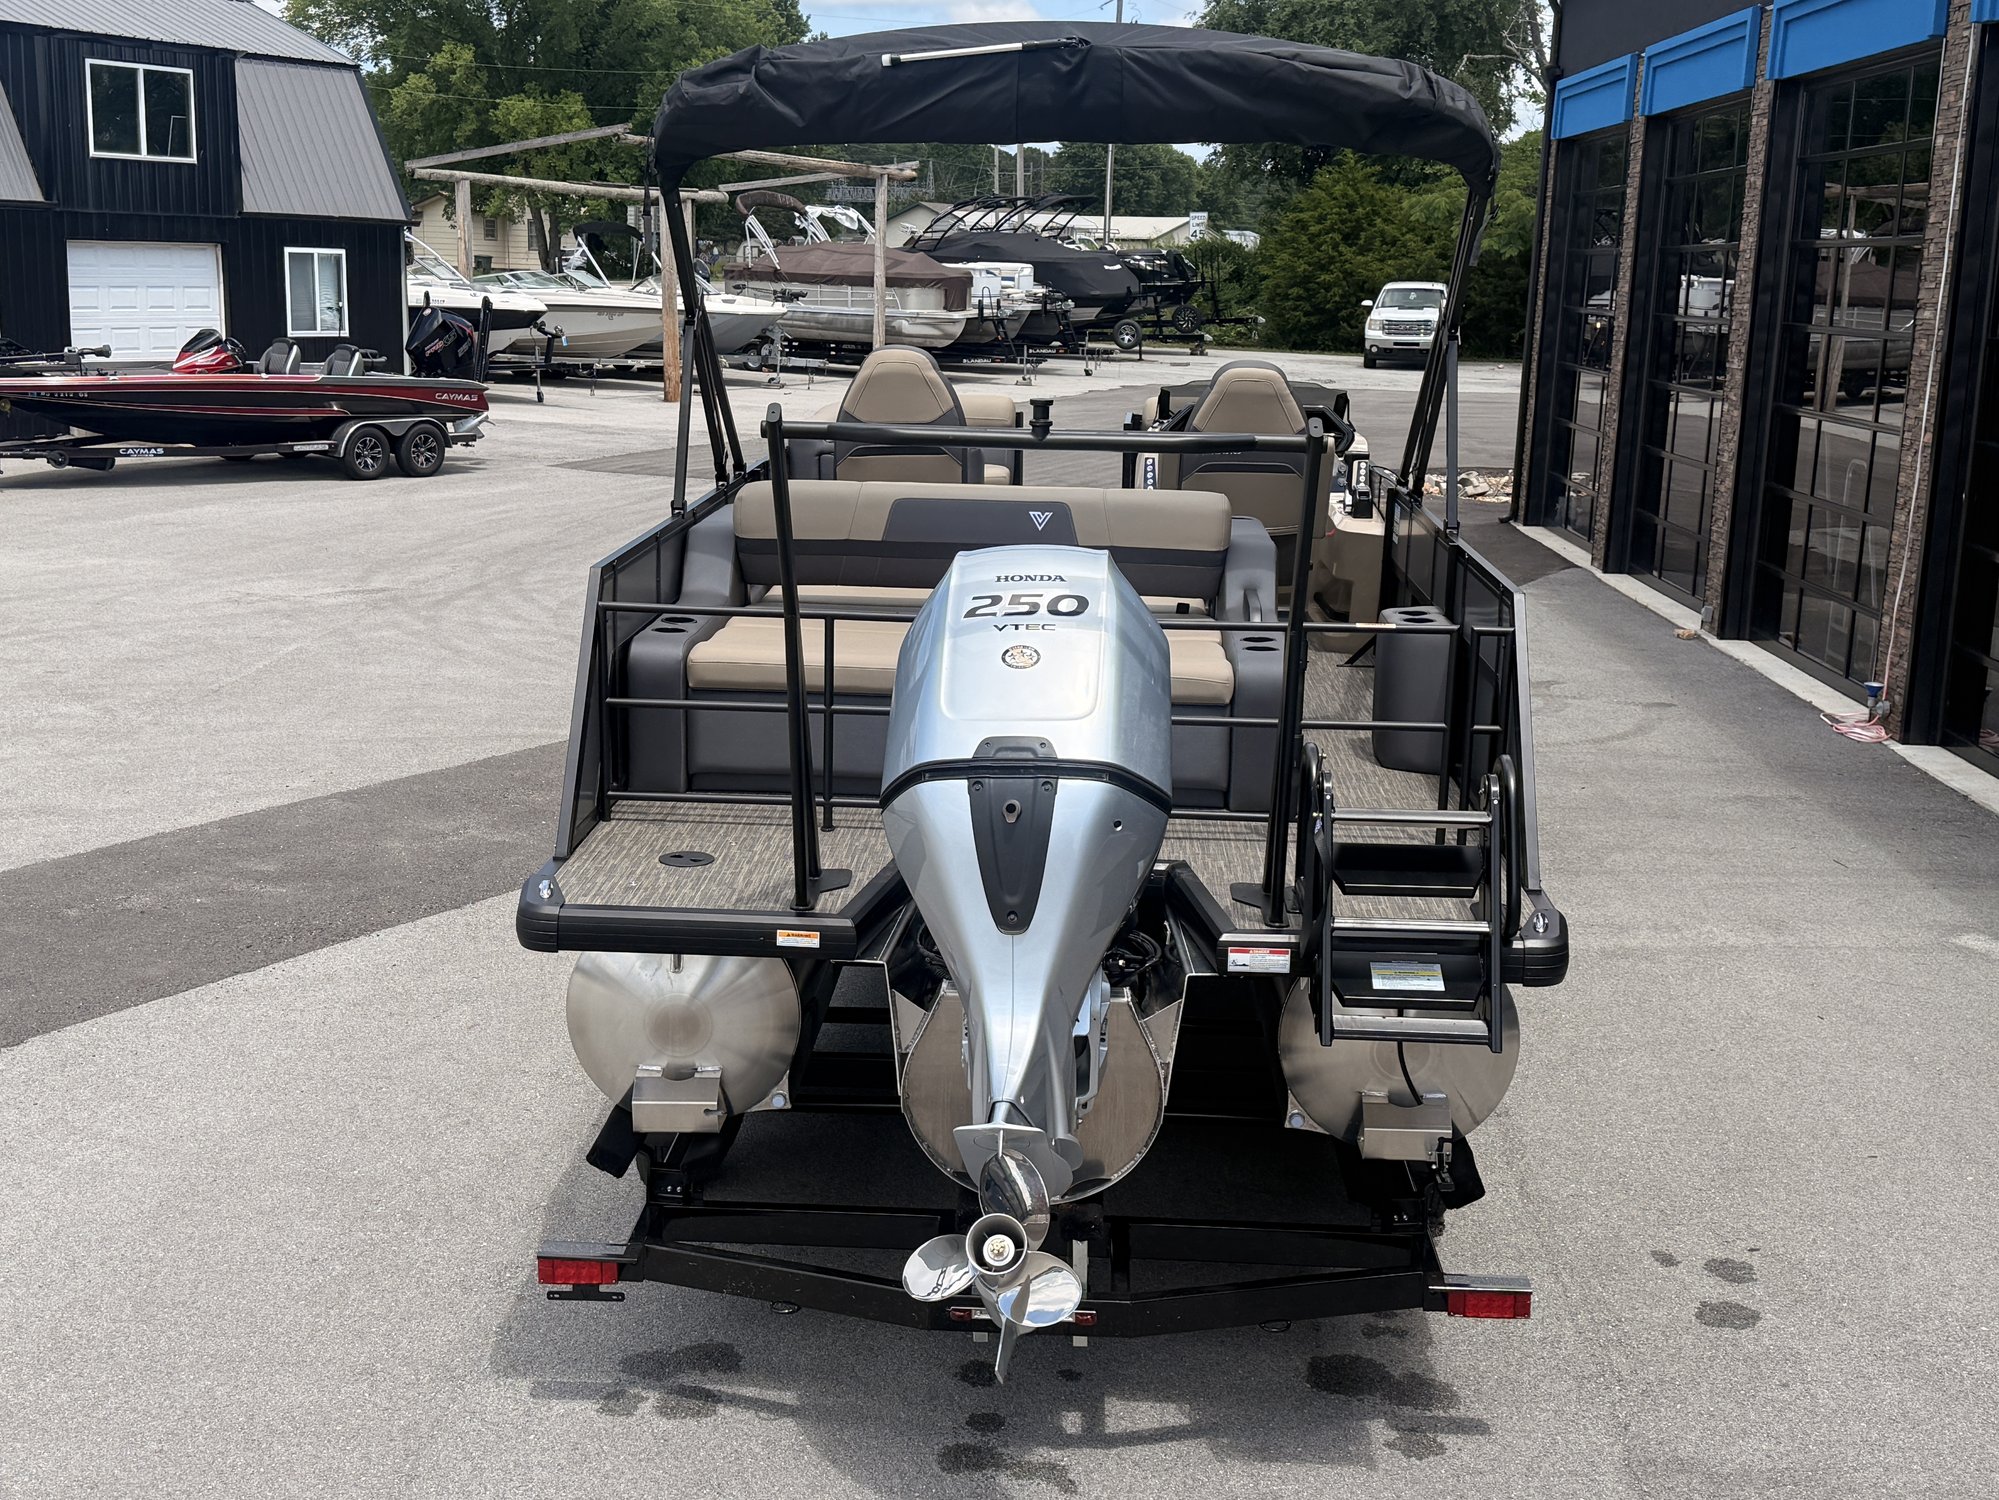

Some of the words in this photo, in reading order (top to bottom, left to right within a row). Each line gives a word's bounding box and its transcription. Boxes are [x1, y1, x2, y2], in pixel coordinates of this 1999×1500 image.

[1191, 229, 1206, 239] 45
[435, 392, 479, 401] CAYMAS
[119, 447, 165, 455] CAYMAS
[995, 574, 1067, 583] HONDA
[963, 594, 1090, 618] 250
[993, 623, 1057, 632] VTEC
